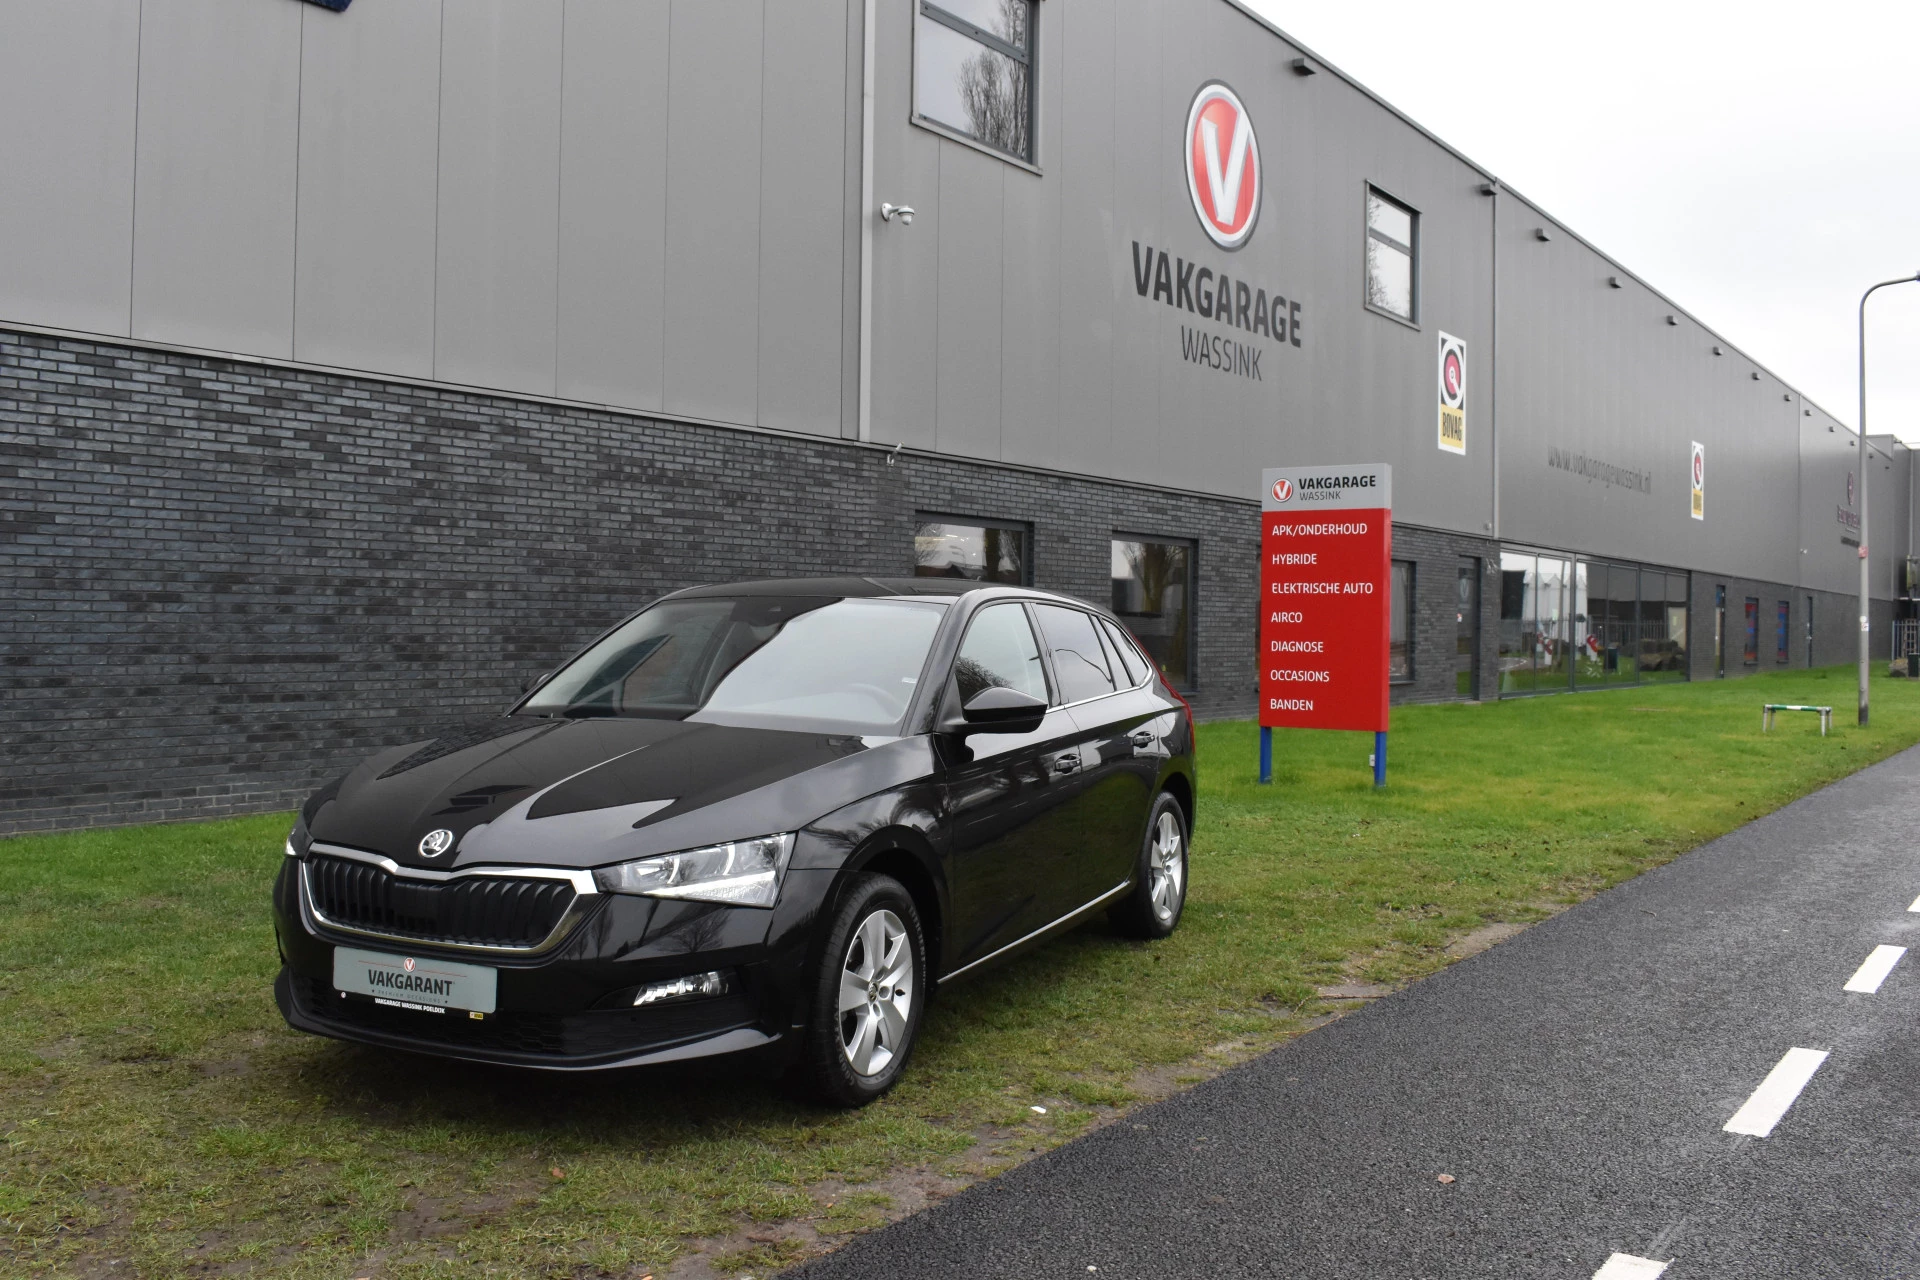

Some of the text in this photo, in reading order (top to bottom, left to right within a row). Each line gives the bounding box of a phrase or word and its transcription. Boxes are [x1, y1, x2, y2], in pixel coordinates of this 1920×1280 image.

[1131, 239, 1301, 350] VAKGARAGE
[1180, 324, 1262, 382] WASSINK
[1442, 411, 1463, 442] BOVAG
[1298, 475, 1376, 490] VAKGARAGE
[1299, 490, 1341, 501] WASSINK
[1272, 523, 1368, 537] APK/ONDERHOUD
[1272, 553, 1317, 565] HYBRIDE
[1271, 582, 1373, 595] ELEKTRISCHE AUTO
[1271, 611, 1303, 623] AIRCO
[1271, 640, 1324, 653] DIAGNOSE
[1270, 669, 1330, 682] OCCASIONS
[1270, 698, 1314, 711] BANDEN
[368, 968, 452, 996] VAKGARANT
[375, 997, 401, 1007] VAKGARAGE
[401, 1002, 422, 1011] WASSINK
